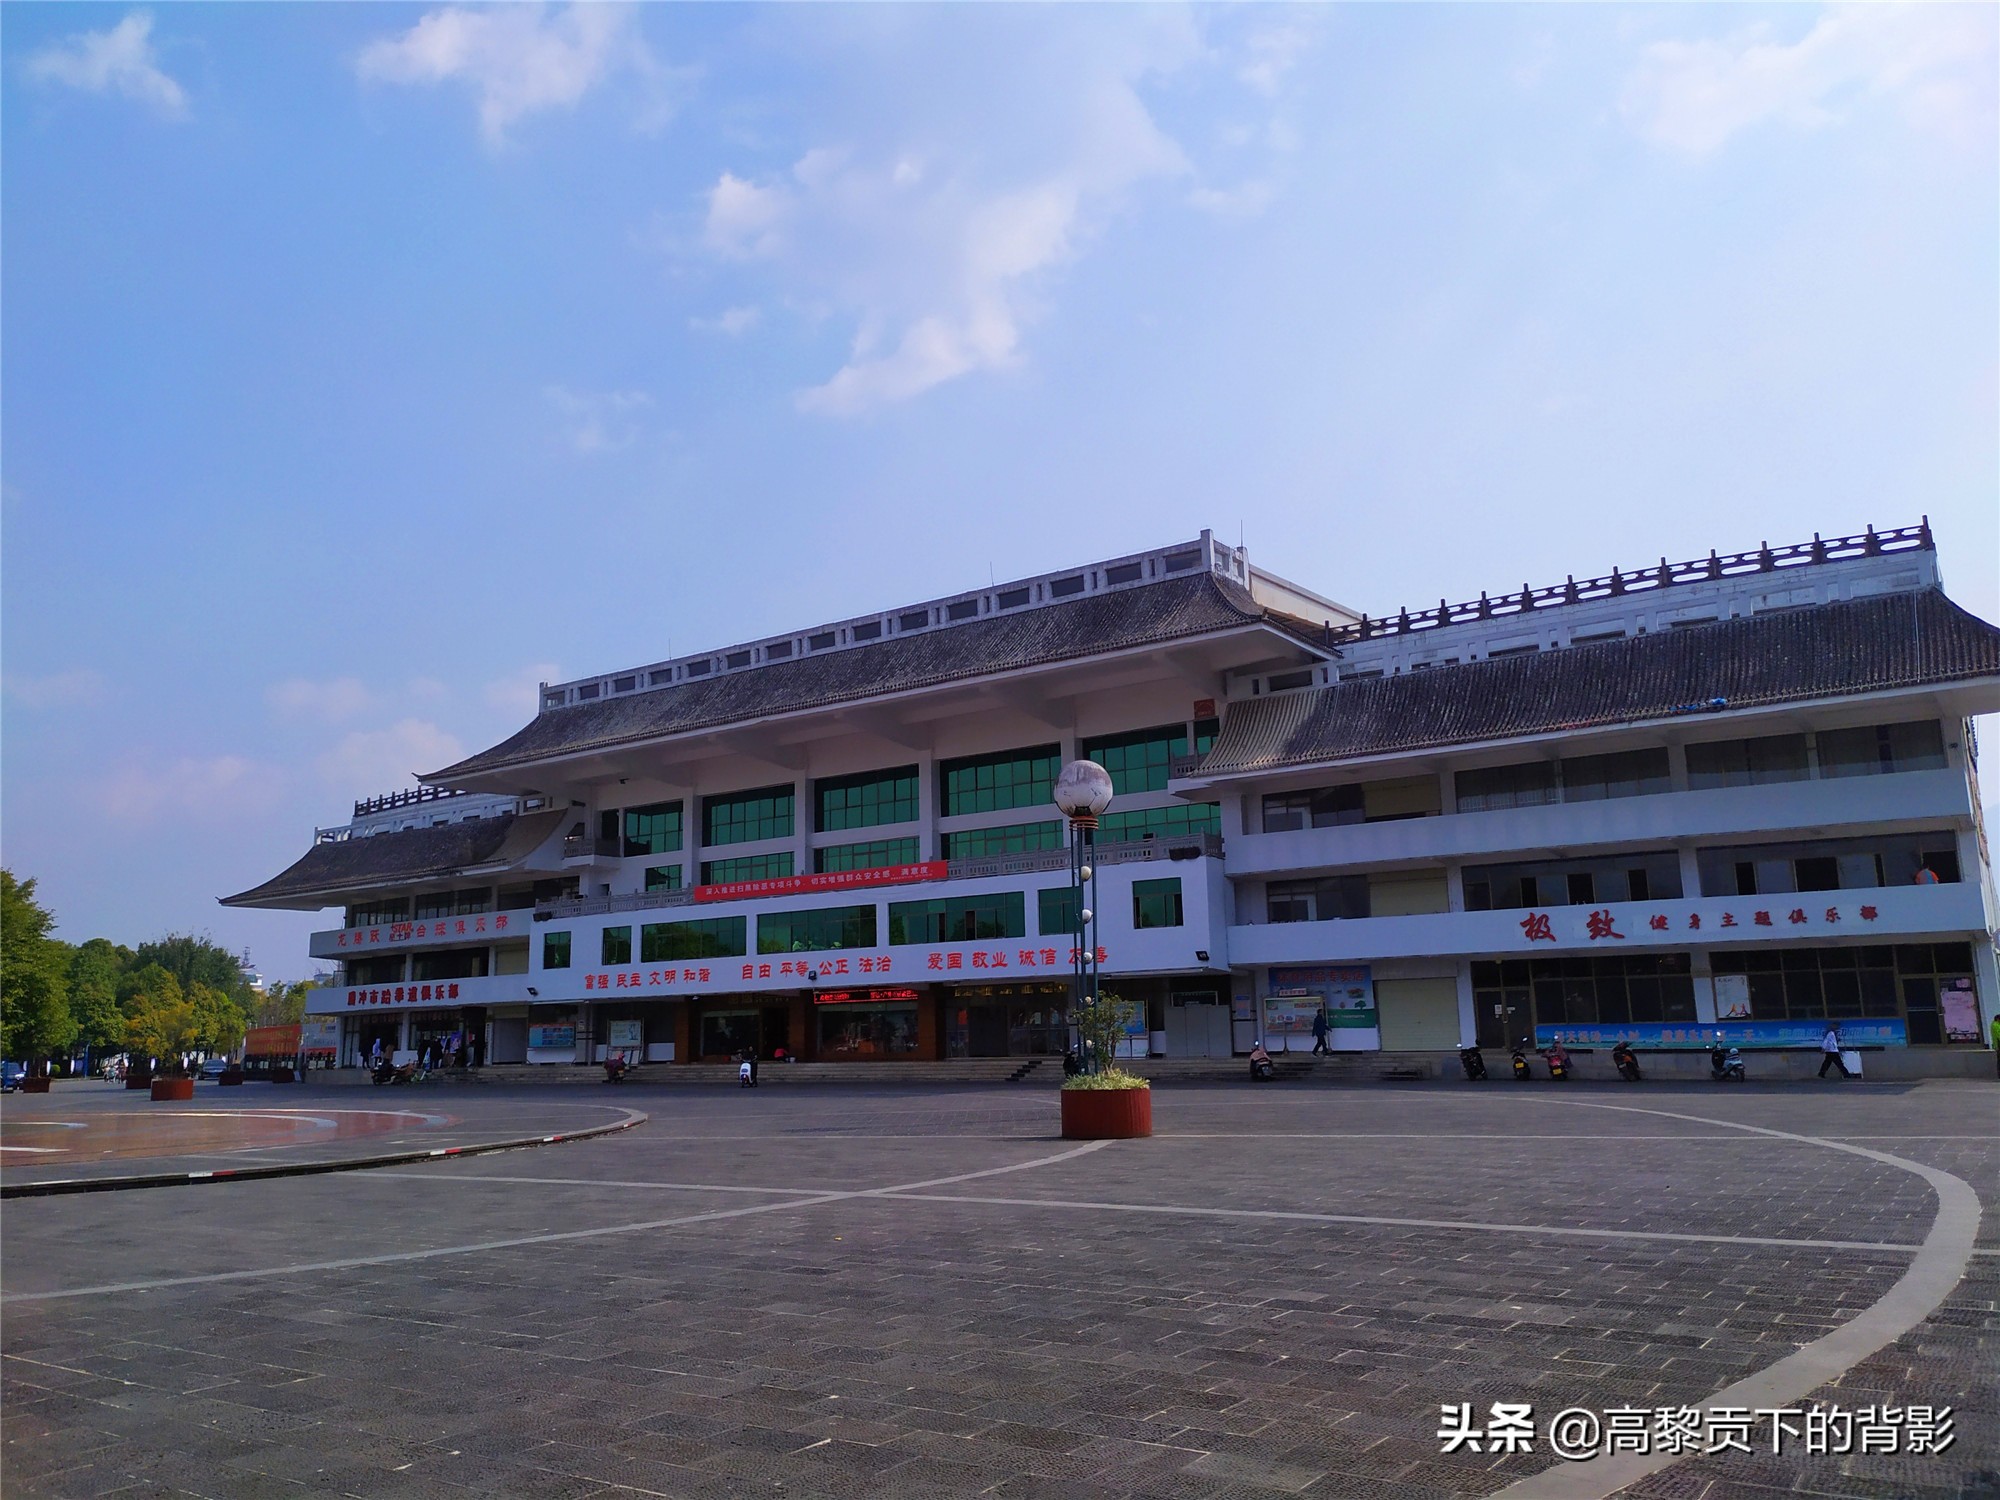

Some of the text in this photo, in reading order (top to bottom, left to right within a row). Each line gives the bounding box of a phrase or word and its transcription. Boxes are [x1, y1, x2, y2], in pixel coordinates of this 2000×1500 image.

[1519, 905, 1878, 942] 极致 健身主题俱乐部
[584, 973, 609, 990] 富强
[616, 972, 642, 988] 民主
[649, 969, 677, 986] 文明
[683, 967, 711, 984] 和谐
[741, 962, 772, 980] 自由
[779, 959, 810, 977] 平等
[818, 957, 850, 975] 公正
[858, 955, 892, 973] 法治
[926, 951, 963, 971] 爱国
[971, 950, 1009, 969] 敬业
[1018, 947, 1057, 967] 诚信
